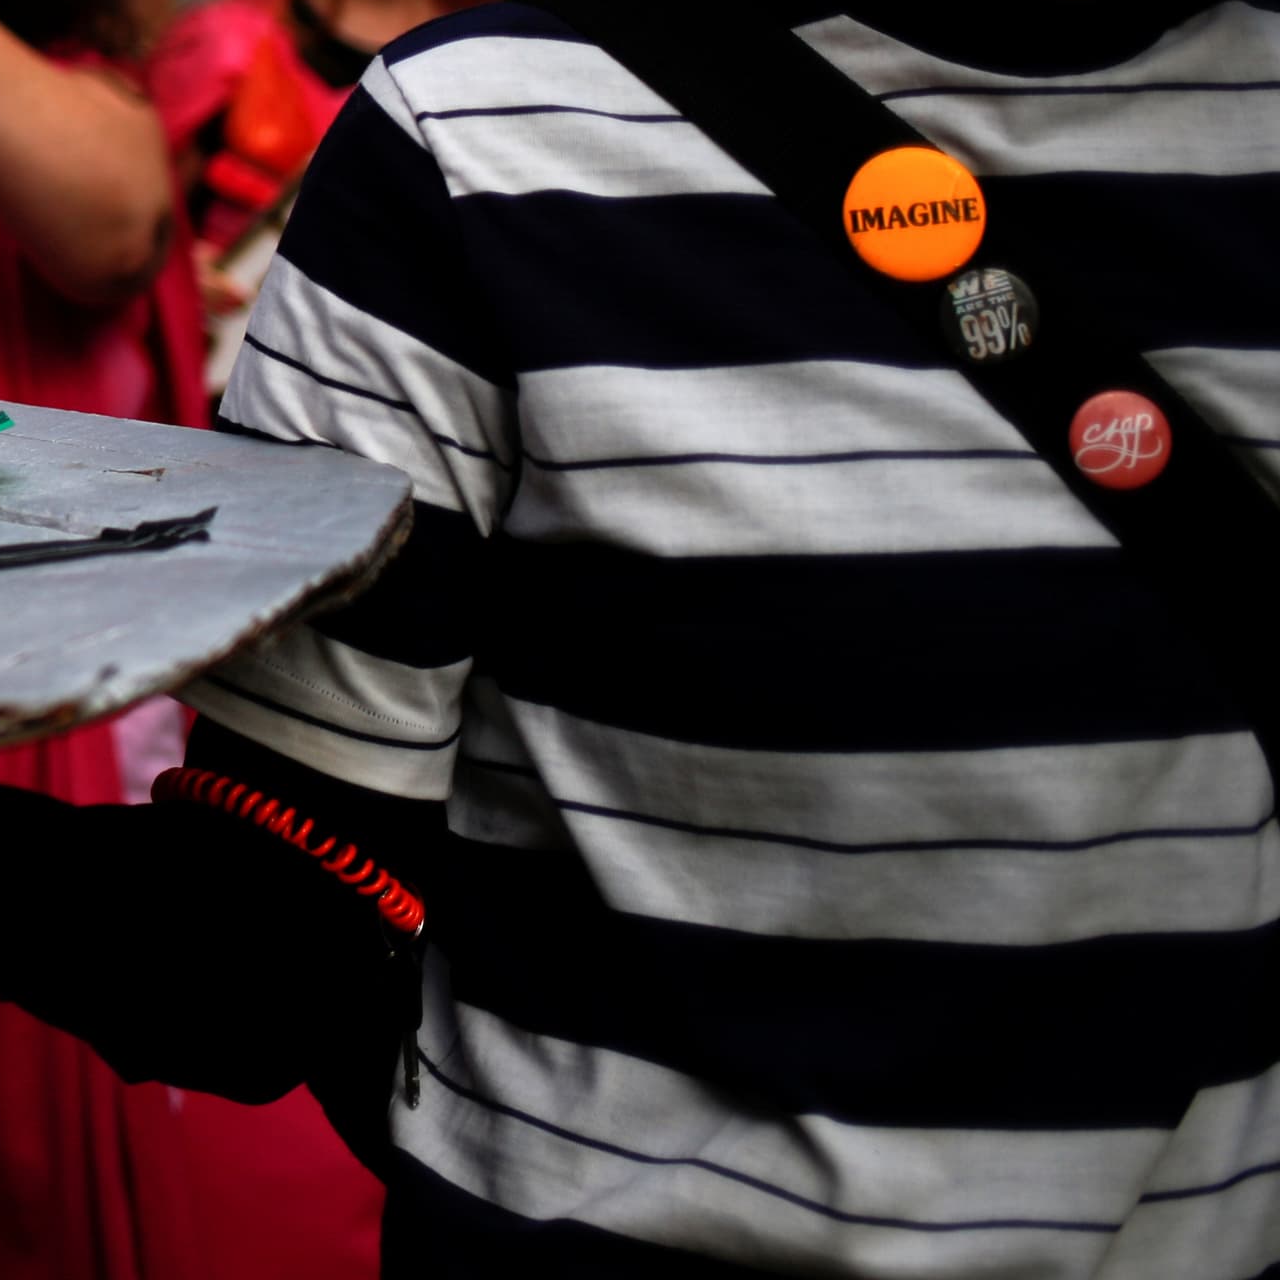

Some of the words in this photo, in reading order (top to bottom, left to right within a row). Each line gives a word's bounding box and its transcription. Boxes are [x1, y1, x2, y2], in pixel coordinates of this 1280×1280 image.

[849, 197, 981, 235] IMAGINE
[947, 268, 1011, 299] WE
[955, 300, 984, 315] ARE
[986, 291, 1016, 305] THE
[960, 302, 1032, 360] 99%
